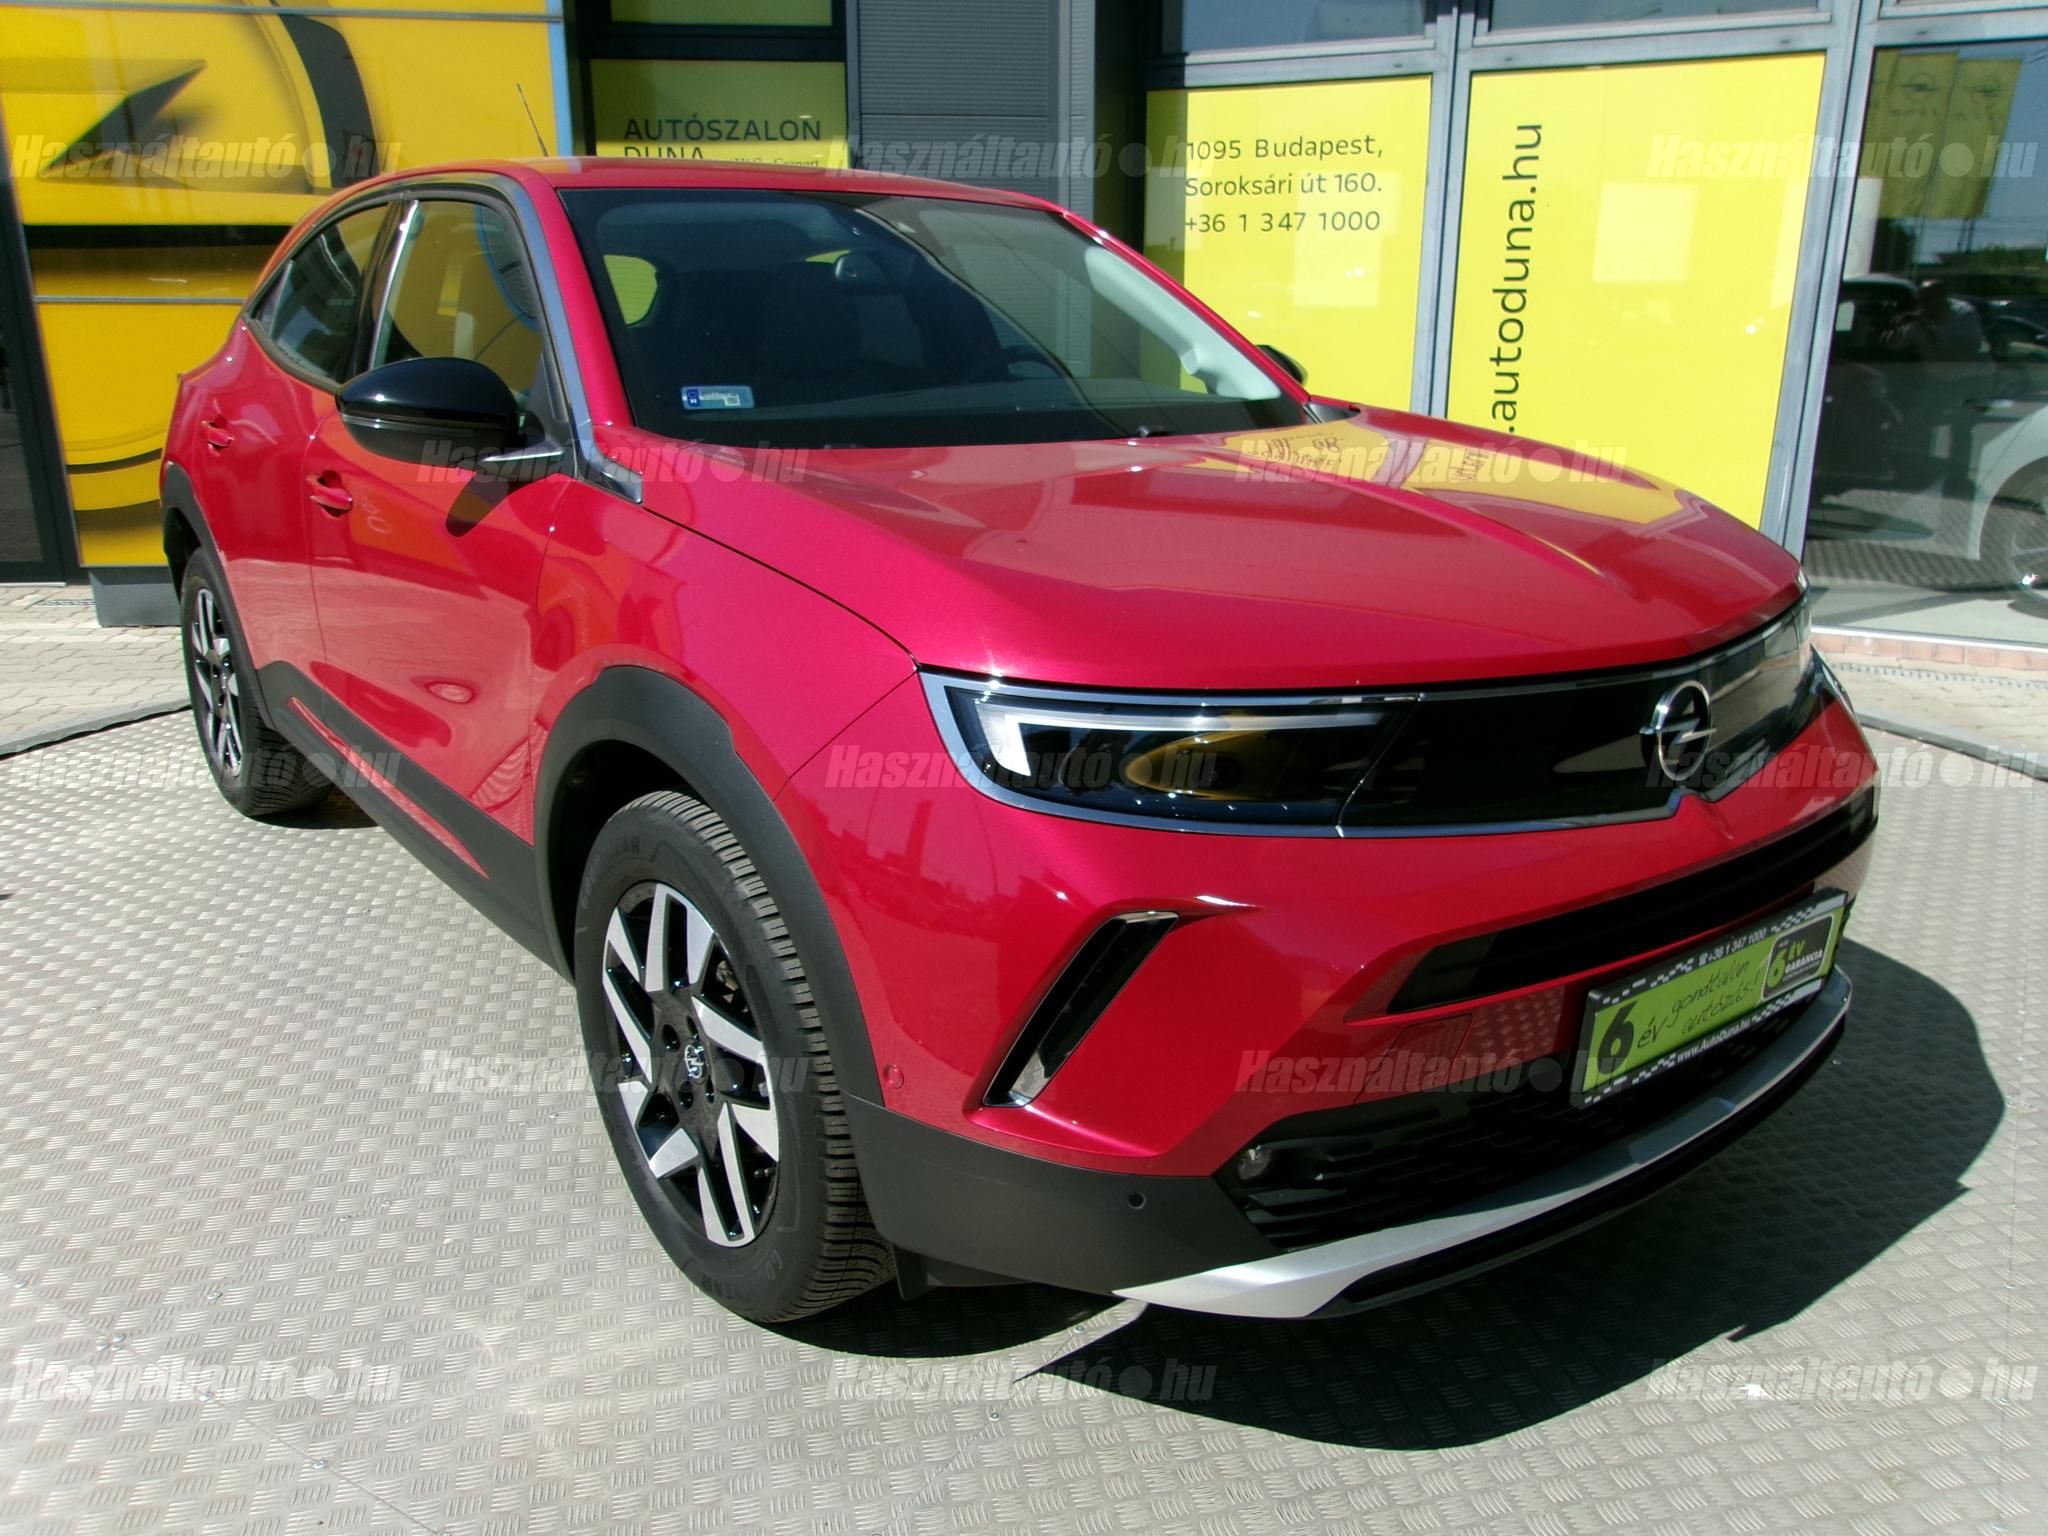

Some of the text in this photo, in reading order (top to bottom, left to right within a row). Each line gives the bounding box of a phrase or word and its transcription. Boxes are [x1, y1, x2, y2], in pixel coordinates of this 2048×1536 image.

[624, 113, 821, 141] AUTÓSZALON
[1187, 134, 1384, 161] 1095 Budapest,
[1184, 172, 1383, 198] Soroksári út 160.
[1184, 210, 1381, 233] +36 1 347 1000
[1767, 948, 1787, 988] 6
[1597, 1001, 1637, 1076] 6
